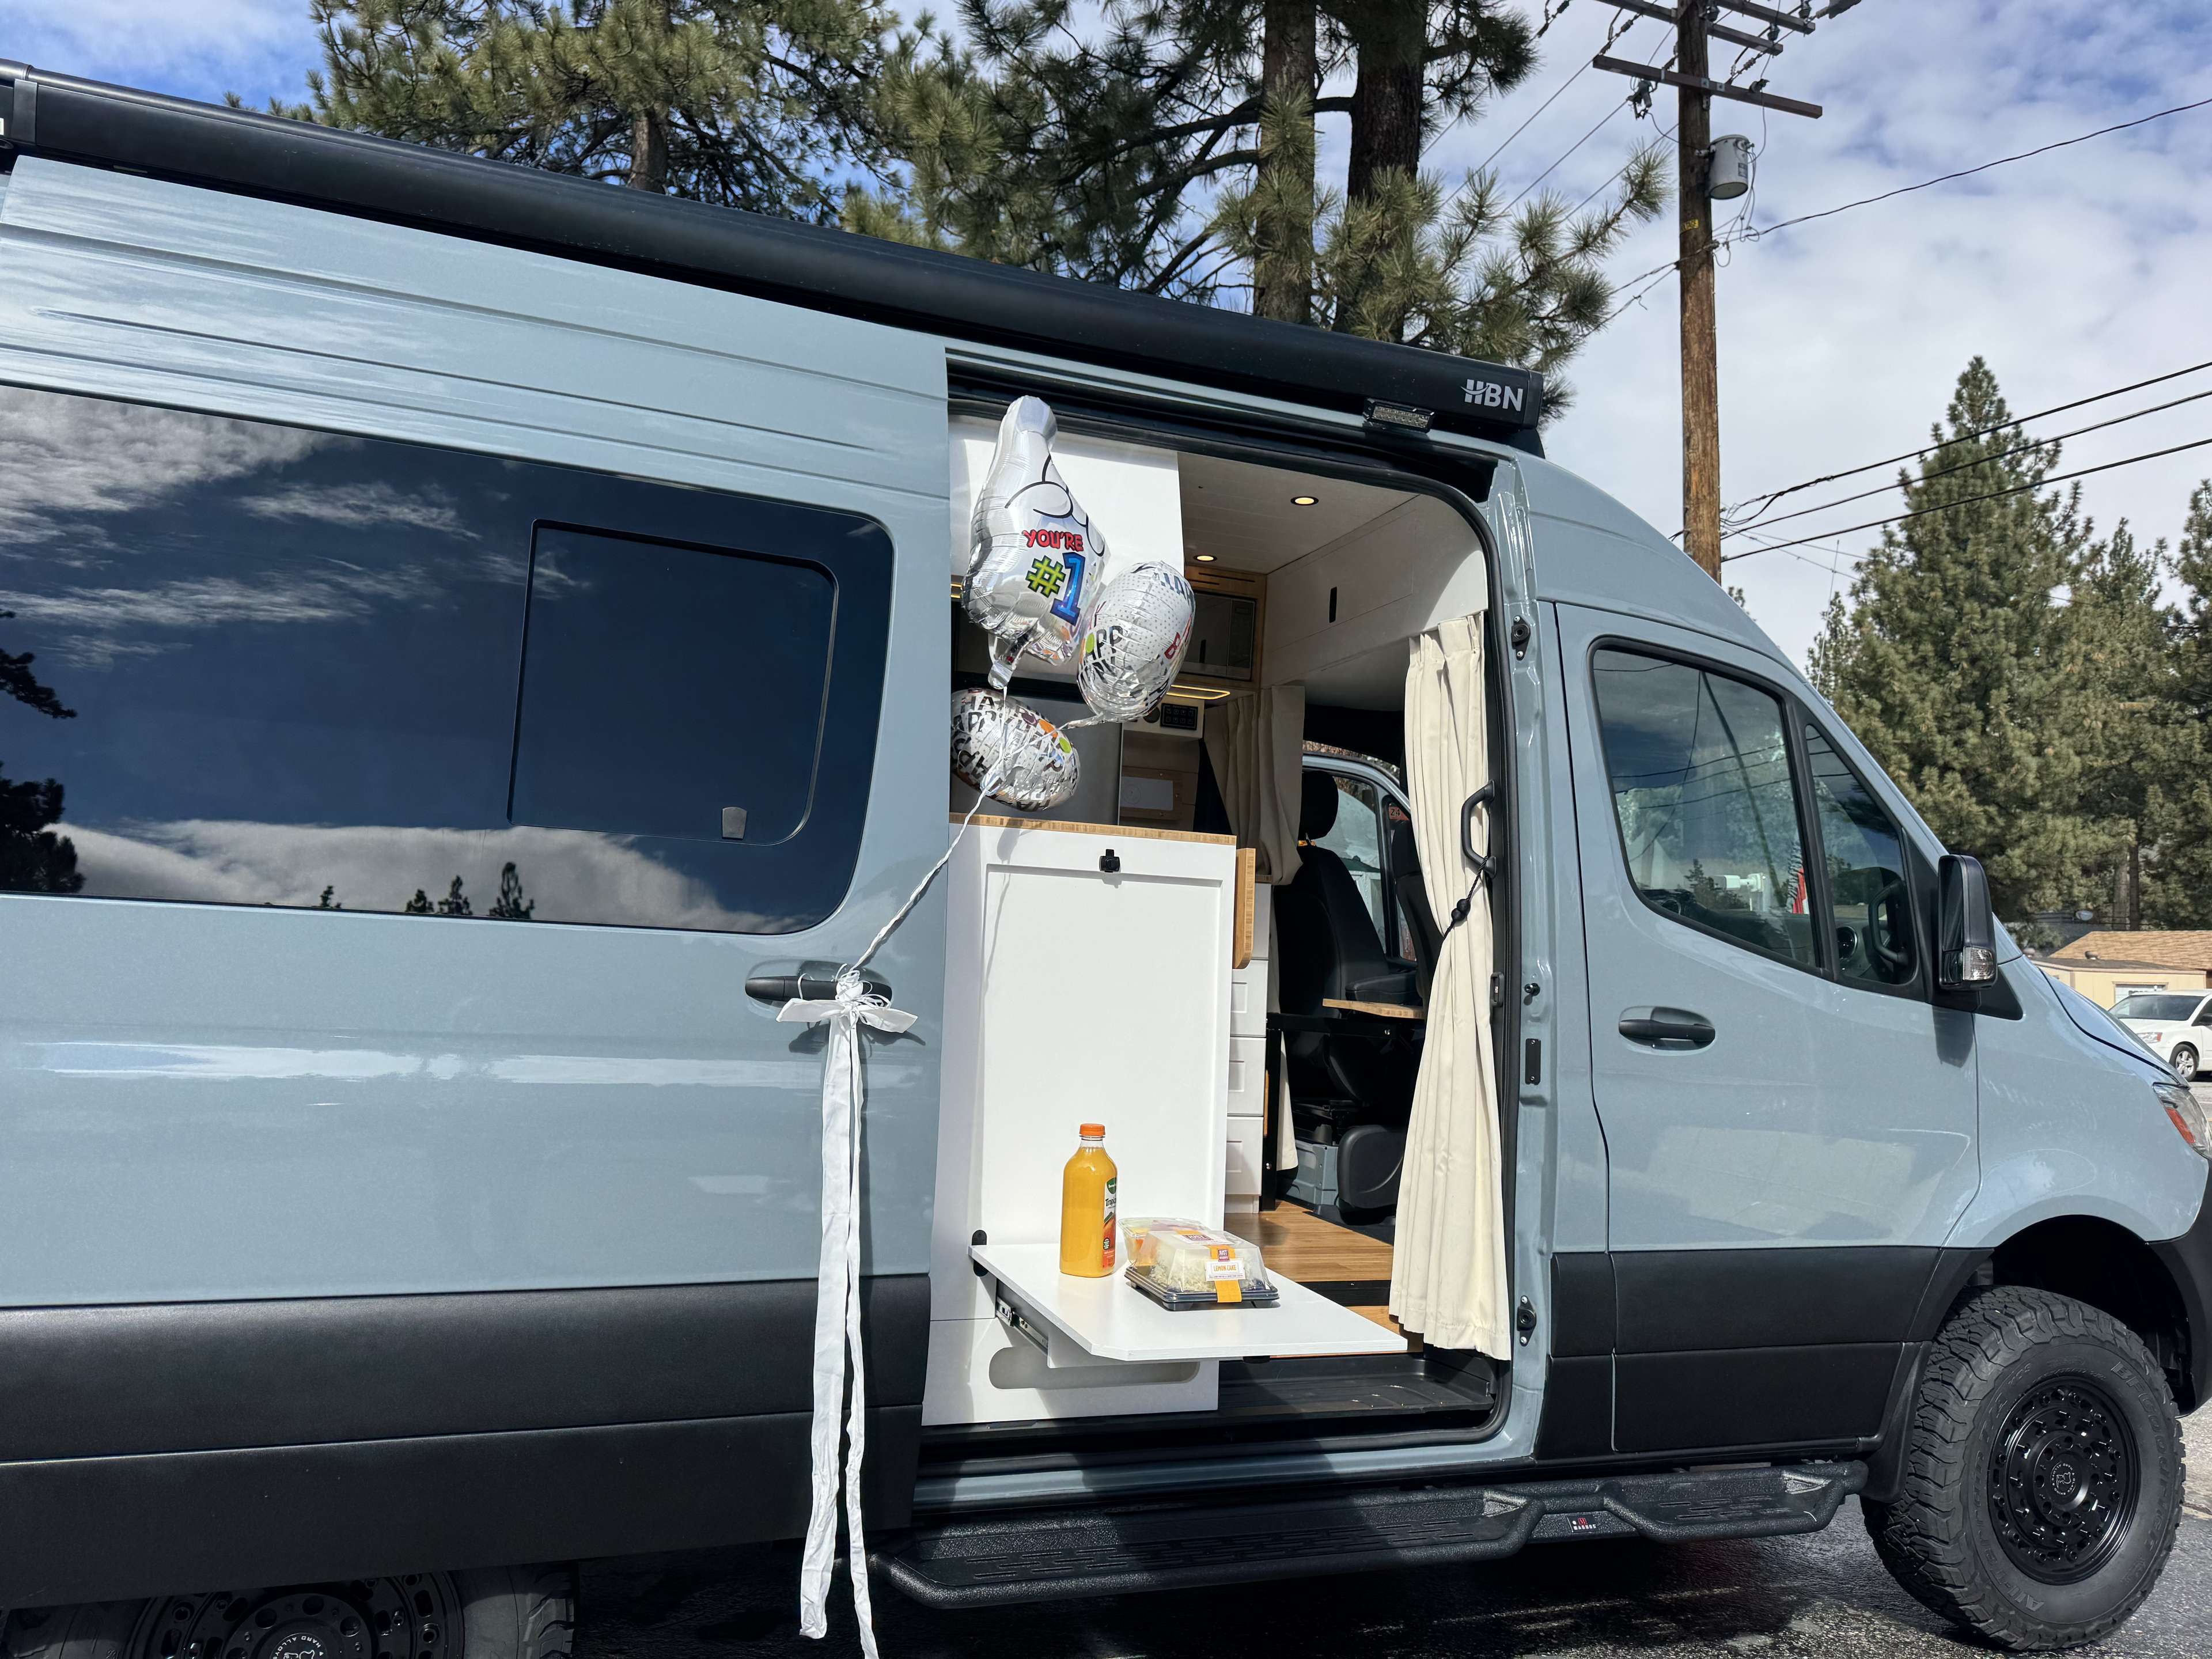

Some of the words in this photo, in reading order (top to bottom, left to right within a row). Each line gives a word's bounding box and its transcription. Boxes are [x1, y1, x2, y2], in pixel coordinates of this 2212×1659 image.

[1461, 378, 1524, 412] HBN
[1021, 529, 1084, 552] YOU'RE
[1025, 552, 1086, 627] #1
